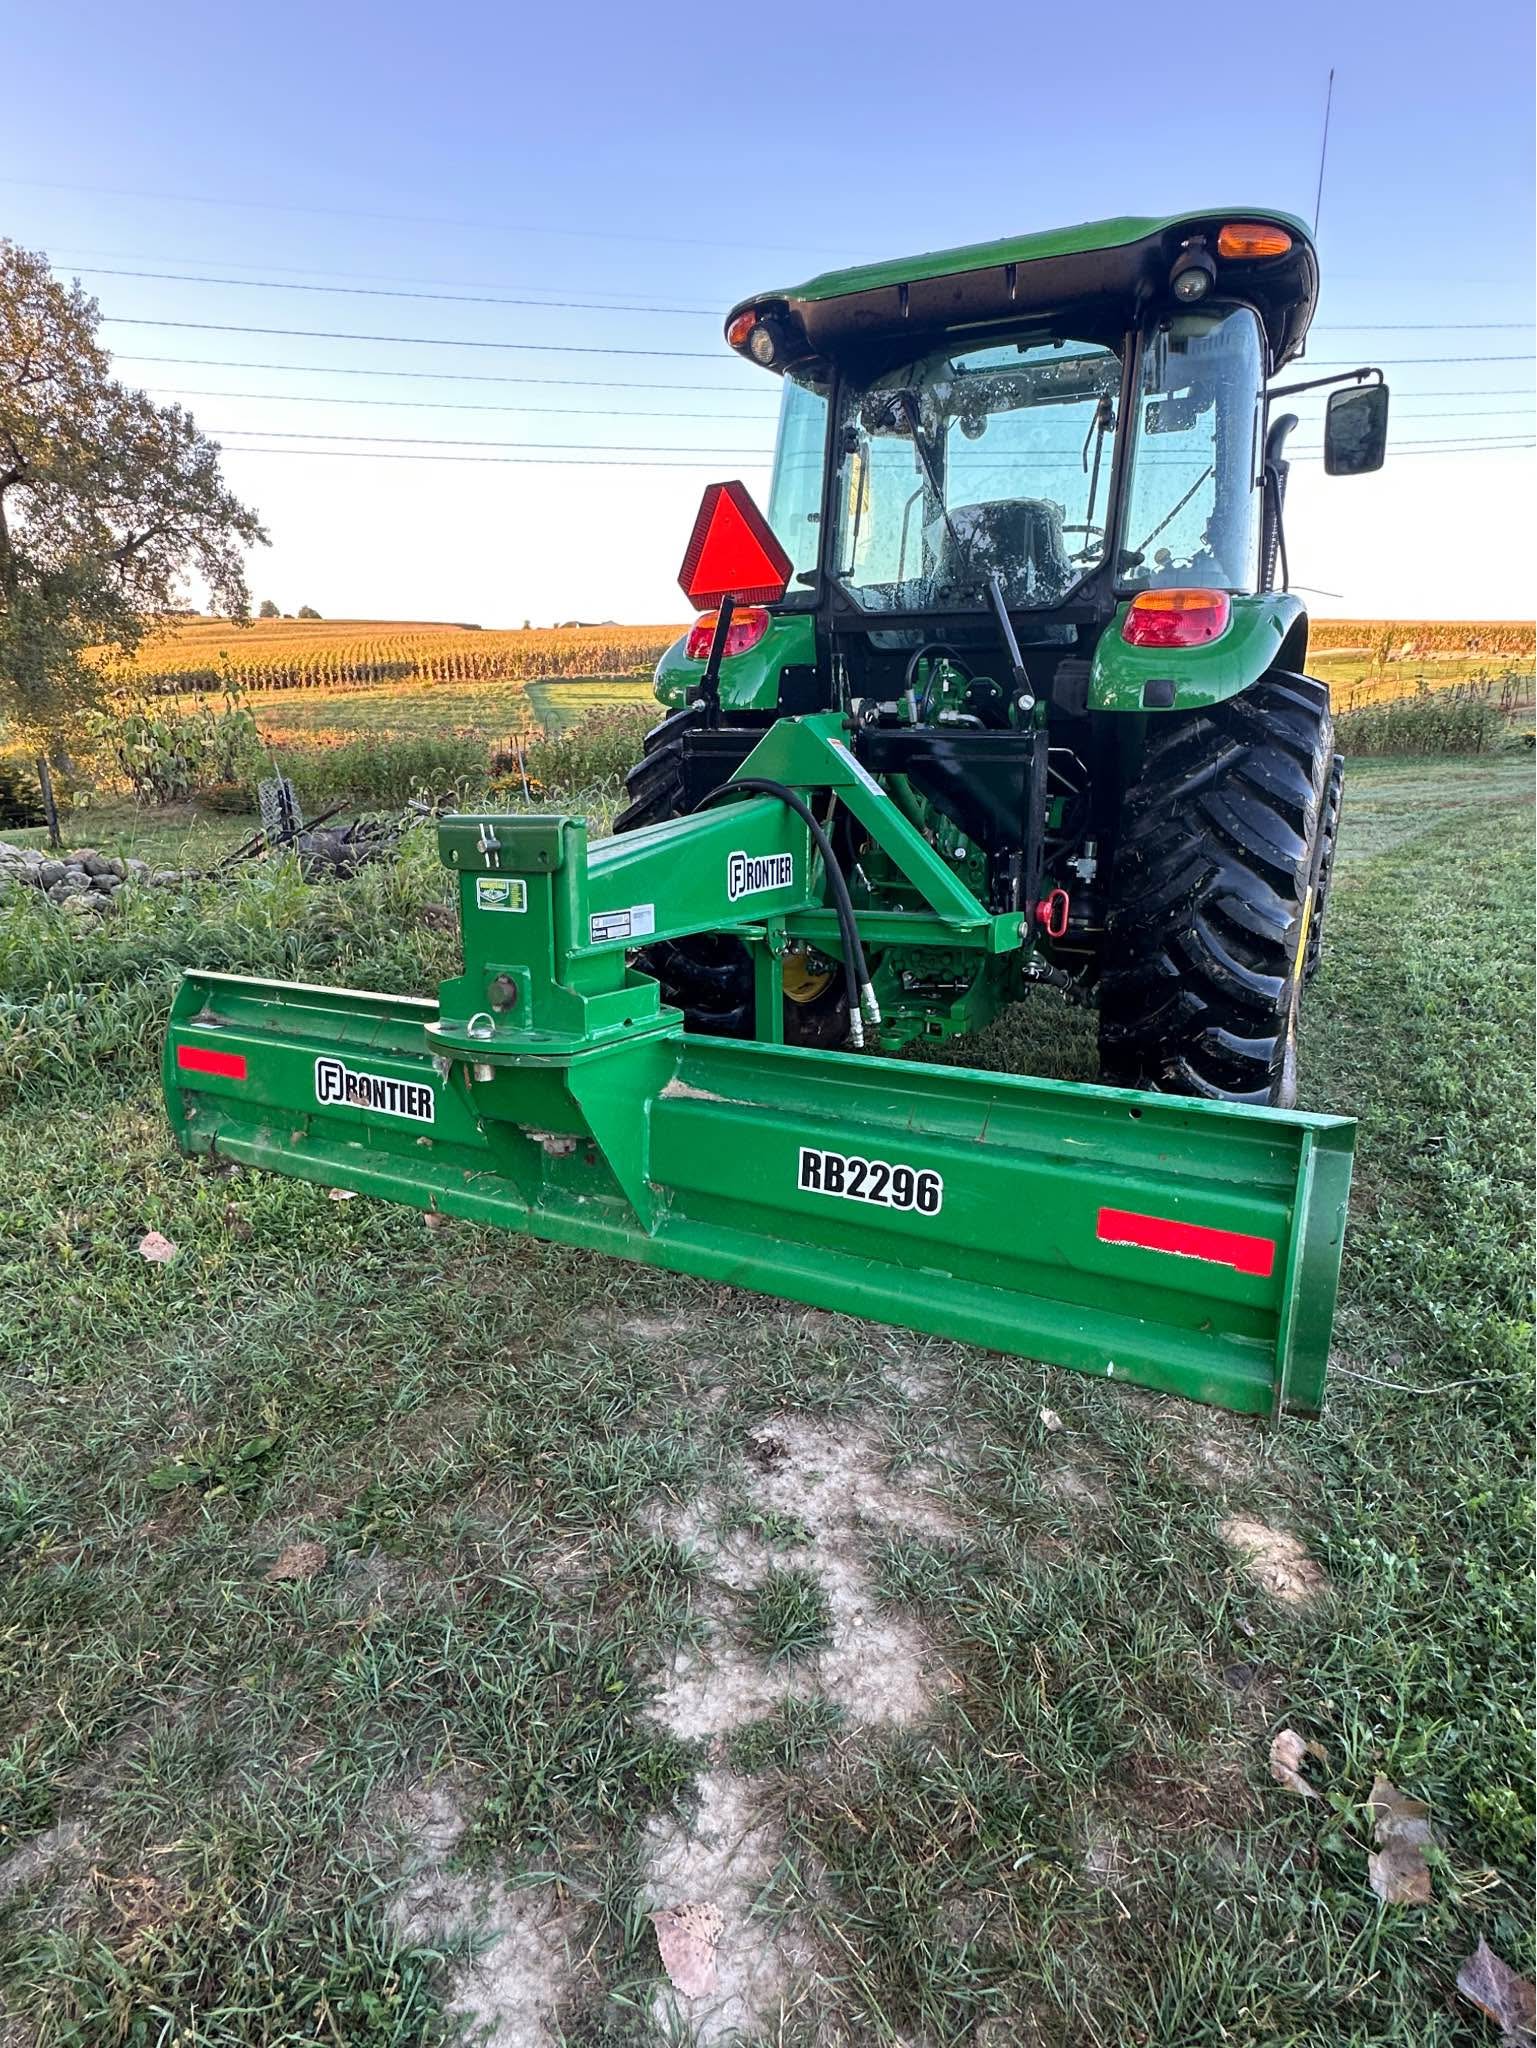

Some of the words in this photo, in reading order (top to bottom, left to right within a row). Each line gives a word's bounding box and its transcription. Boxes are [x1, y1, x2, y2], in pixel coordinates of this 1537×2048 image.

[730, 855, 791, 898] FRONTIER
[318, 1060, 432, 1119] FRONTIER
[801, 1151, 940, 1212] RB2296
